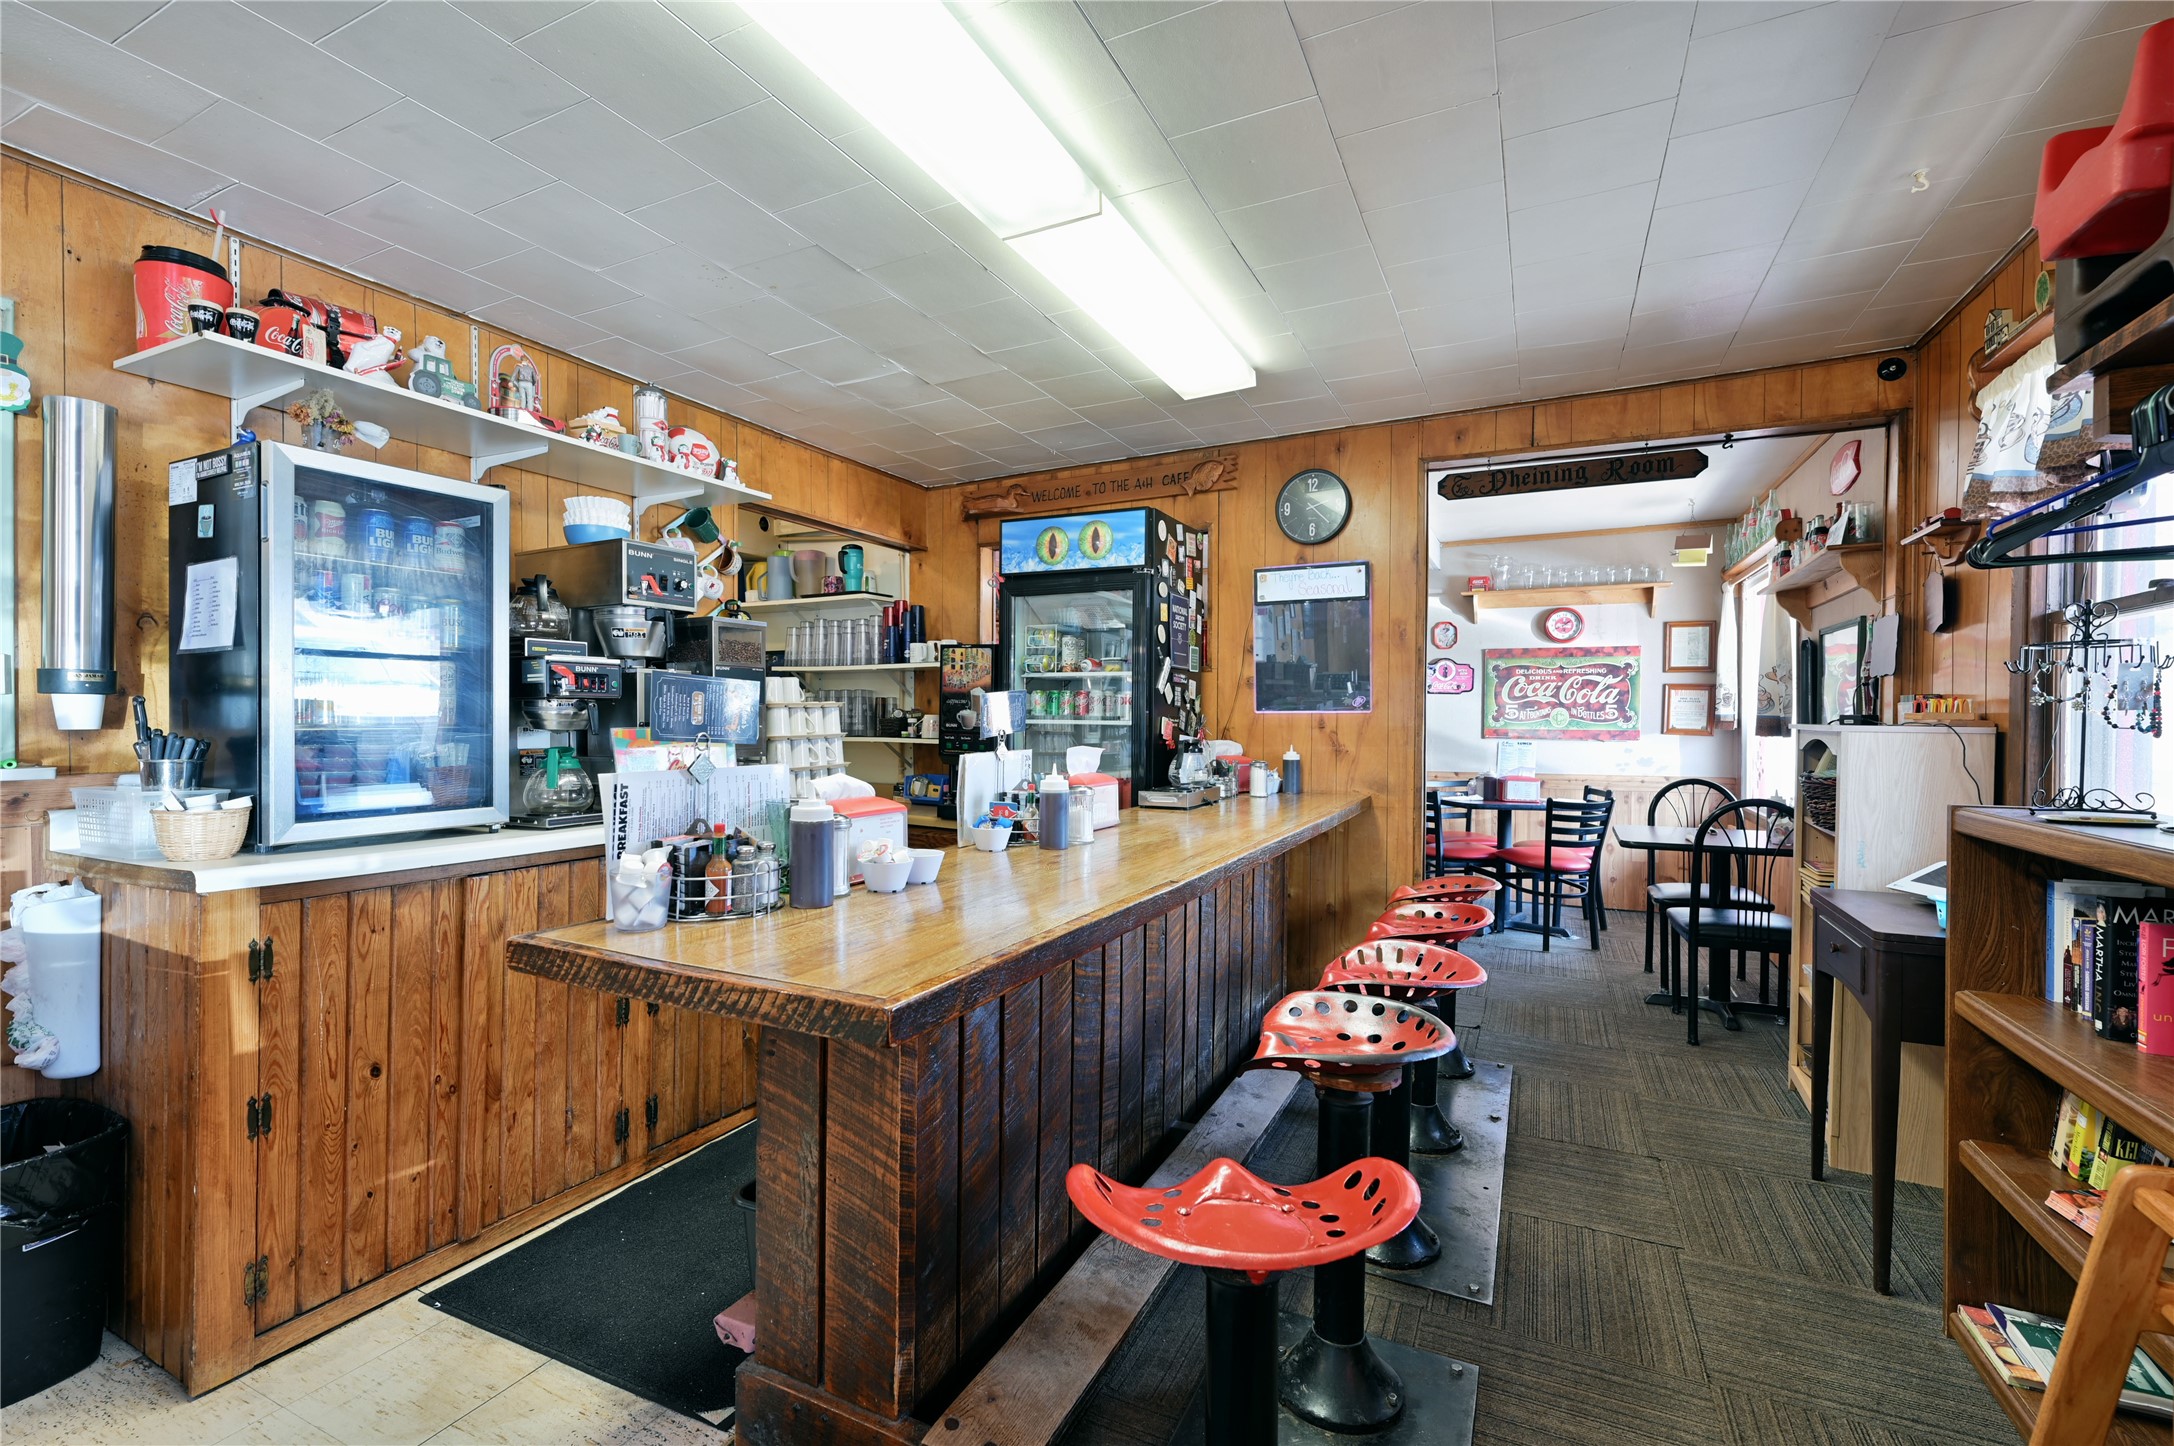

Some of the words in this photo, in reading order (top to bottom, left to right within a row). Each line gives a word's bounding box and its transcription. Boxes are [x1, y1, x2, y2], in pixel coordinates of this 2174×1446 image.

[1600, 457, 1684, 482] Room
[1032, 486, 1081, 503] WELCOME
[1092, 482, 1106, 495] TO
[1110, 478, 1130, 492] THE
[1308, 478, 1318, 492] 12
[1284, 502, 1291, 516] 9
[1309, 523, 1316, 536] 6
[628, 549, 653, 559] BUNN
[1298, 576, 1352, 596] Seasonal
[1172, 604, 1188, 616] NATIONAL
[1173, 620, 1187, 632] SOCIETY
[575, 665, 596, 673] BUNN
[1501, 674, 1624, 704] Coca-Cola
[1577, 706, 1605, 720] BOTTLES
[2095, 925, 2104, 981] MARTHA
[2139, 957, 2147, 982] FOSTER
[2094, 985, 2102, 1013] INC
